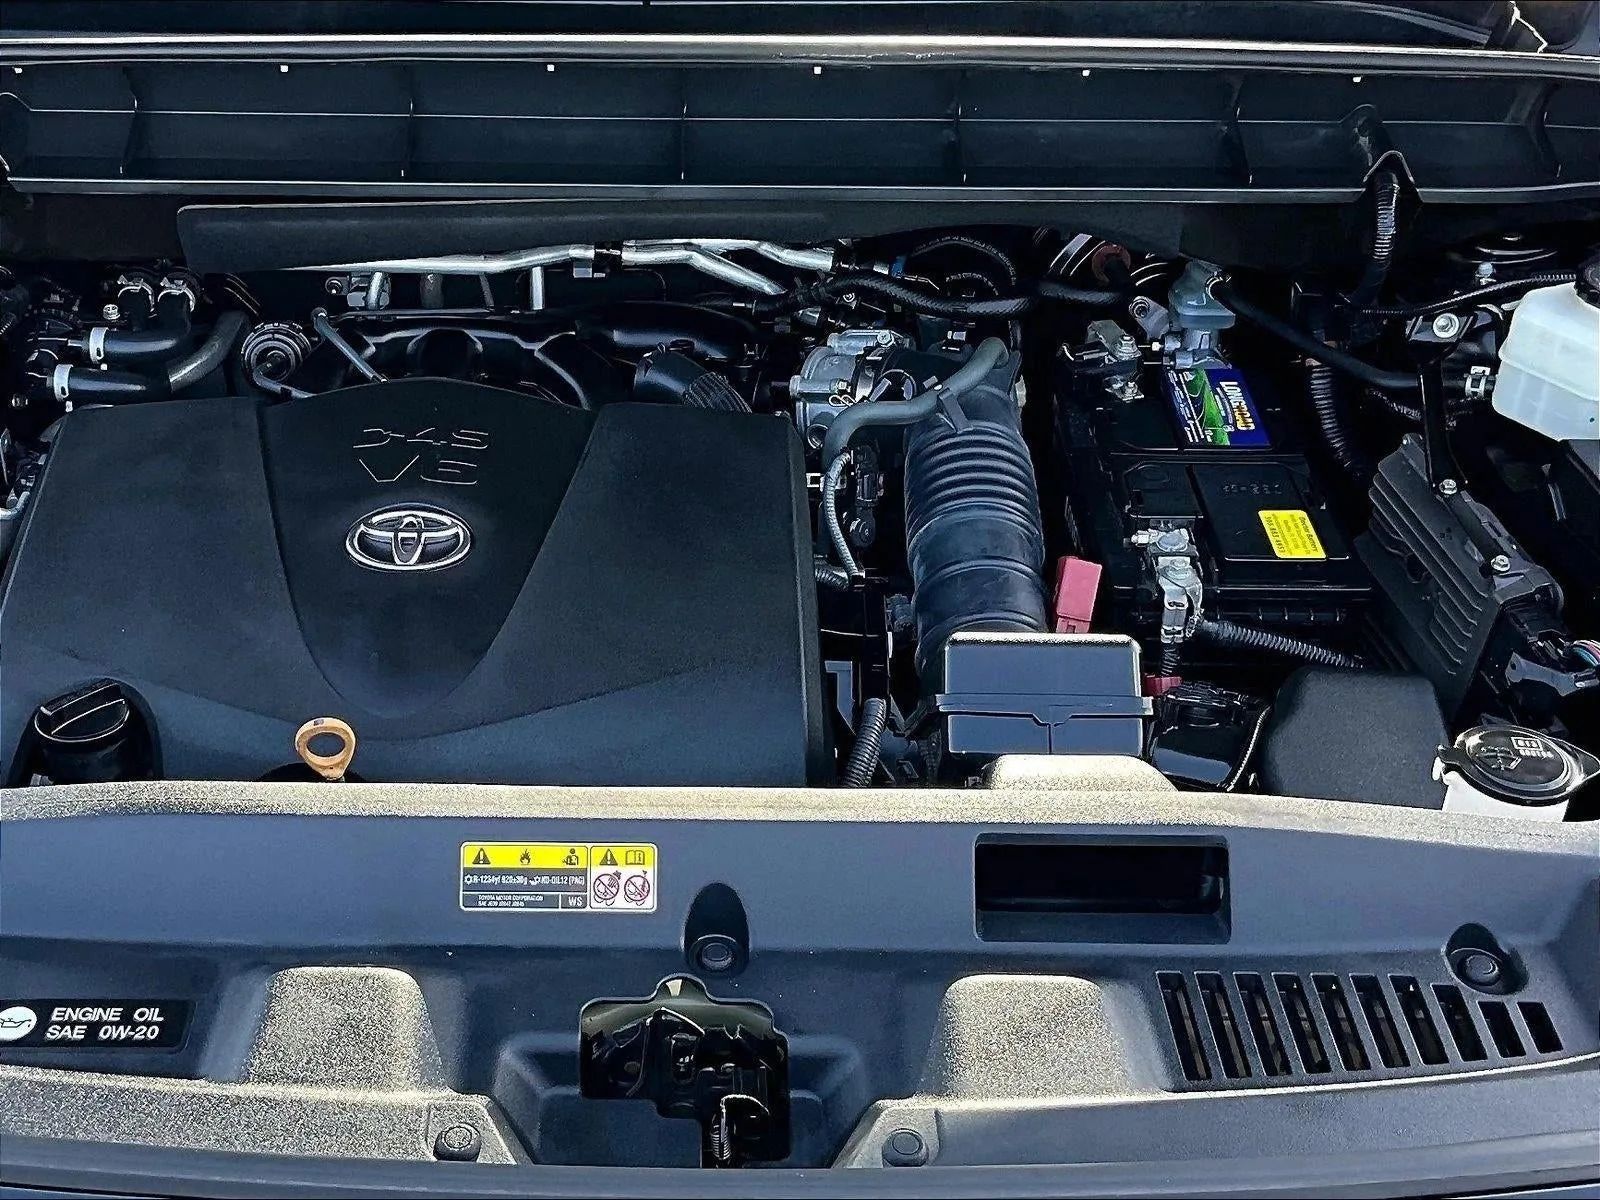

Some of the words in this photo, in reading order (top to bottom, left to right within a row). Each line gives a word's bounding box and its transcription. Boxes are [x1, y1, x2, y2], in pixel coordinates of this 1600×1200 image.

[1219, 381, 1256, 431] LONGROAD
[568, 896, 583, 906] WS
[51, 1007, 124, 1021] ENGINE
[133, 1007, 165, 1021] OIL
[46, 1025, 88, 1039] SAE
[99, 1025, 160, 1040] 0W-20
